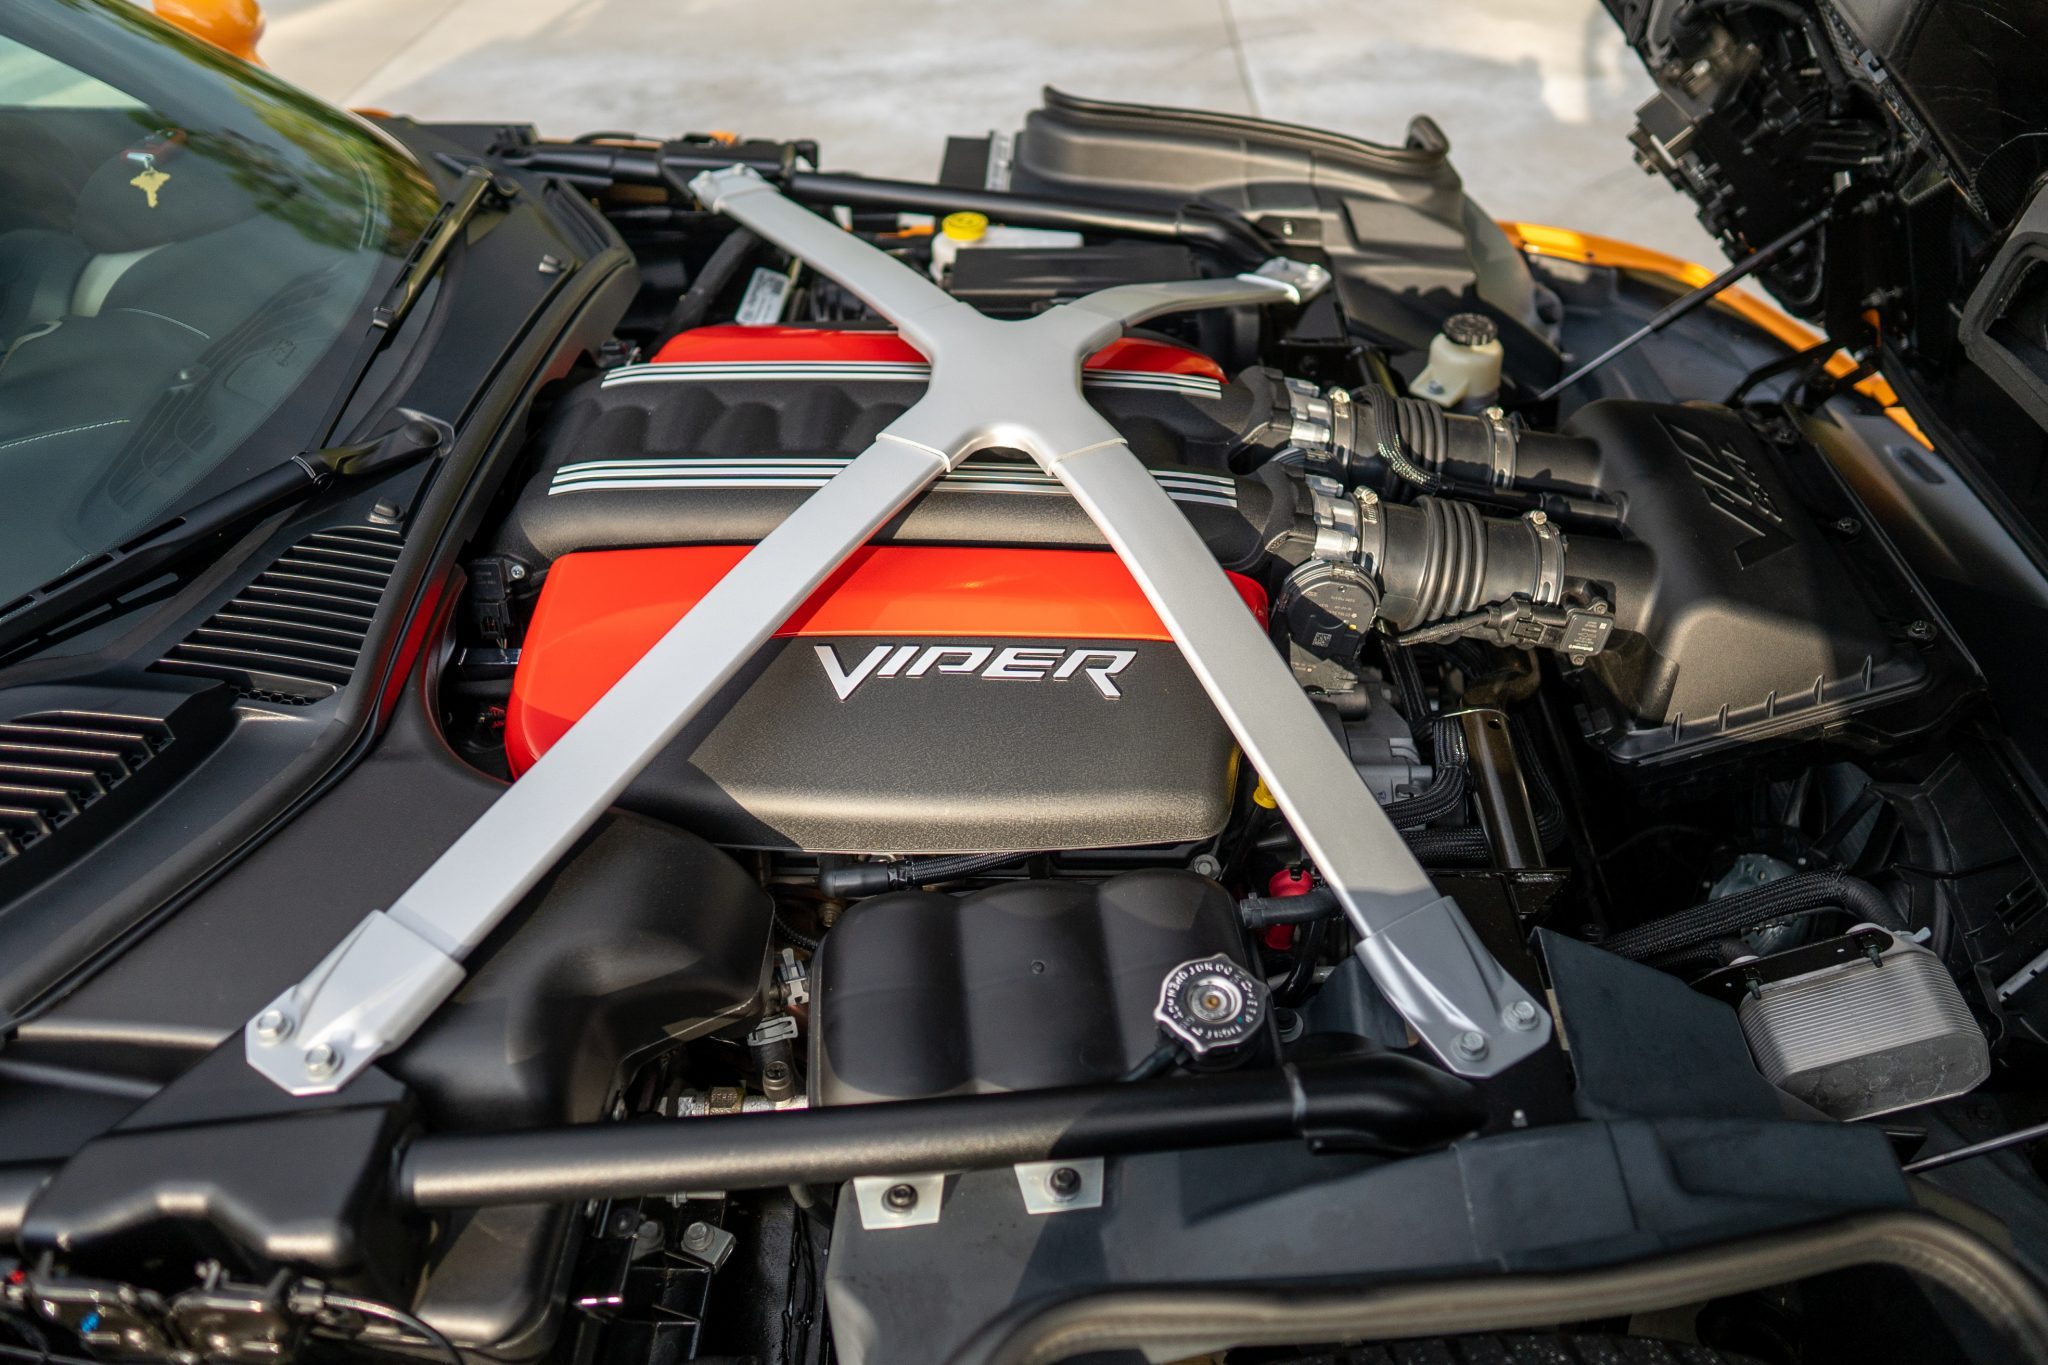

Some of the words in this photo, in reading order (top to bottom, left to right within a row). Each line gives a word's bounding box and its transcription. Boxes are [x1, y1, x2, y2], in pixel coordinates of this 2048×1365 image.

[813, 644, 1138, 701] VIPER
[1188, 962, 1213, 975] NOT
[1215, 963, 1233, 975] DO
[1167, 970, 1189, 998] OPEN
